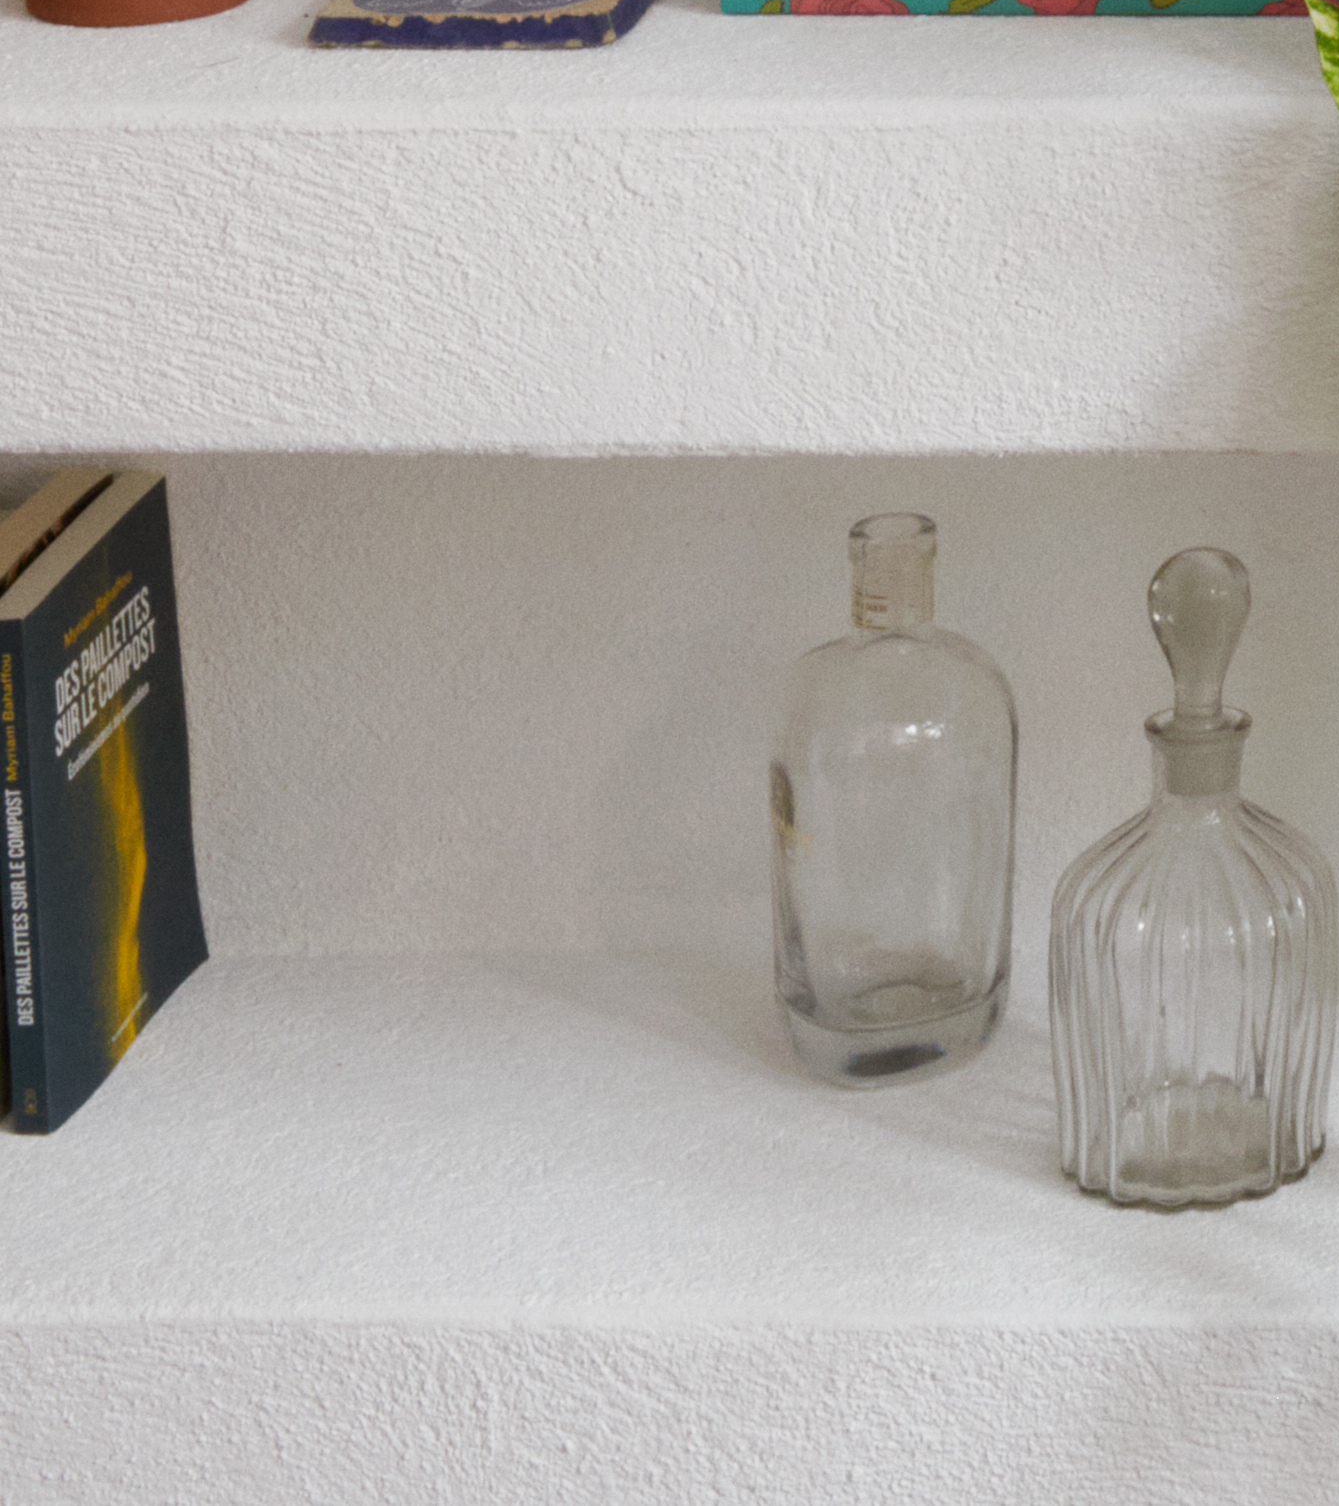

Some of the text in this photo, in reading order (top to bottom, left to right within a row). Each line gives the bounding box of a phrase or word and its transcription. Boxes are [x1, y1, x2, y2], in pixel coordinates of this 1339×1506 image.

[54, 617, 156, 758] SUR LE COMPOST
[55, 659, 80, 715] DES
[80, 585, 150, 687] PAILLETTES
[1, 653, 34, 1027] DES PAILLETTES SUR LE COMPOST Myriam Bahaffou
